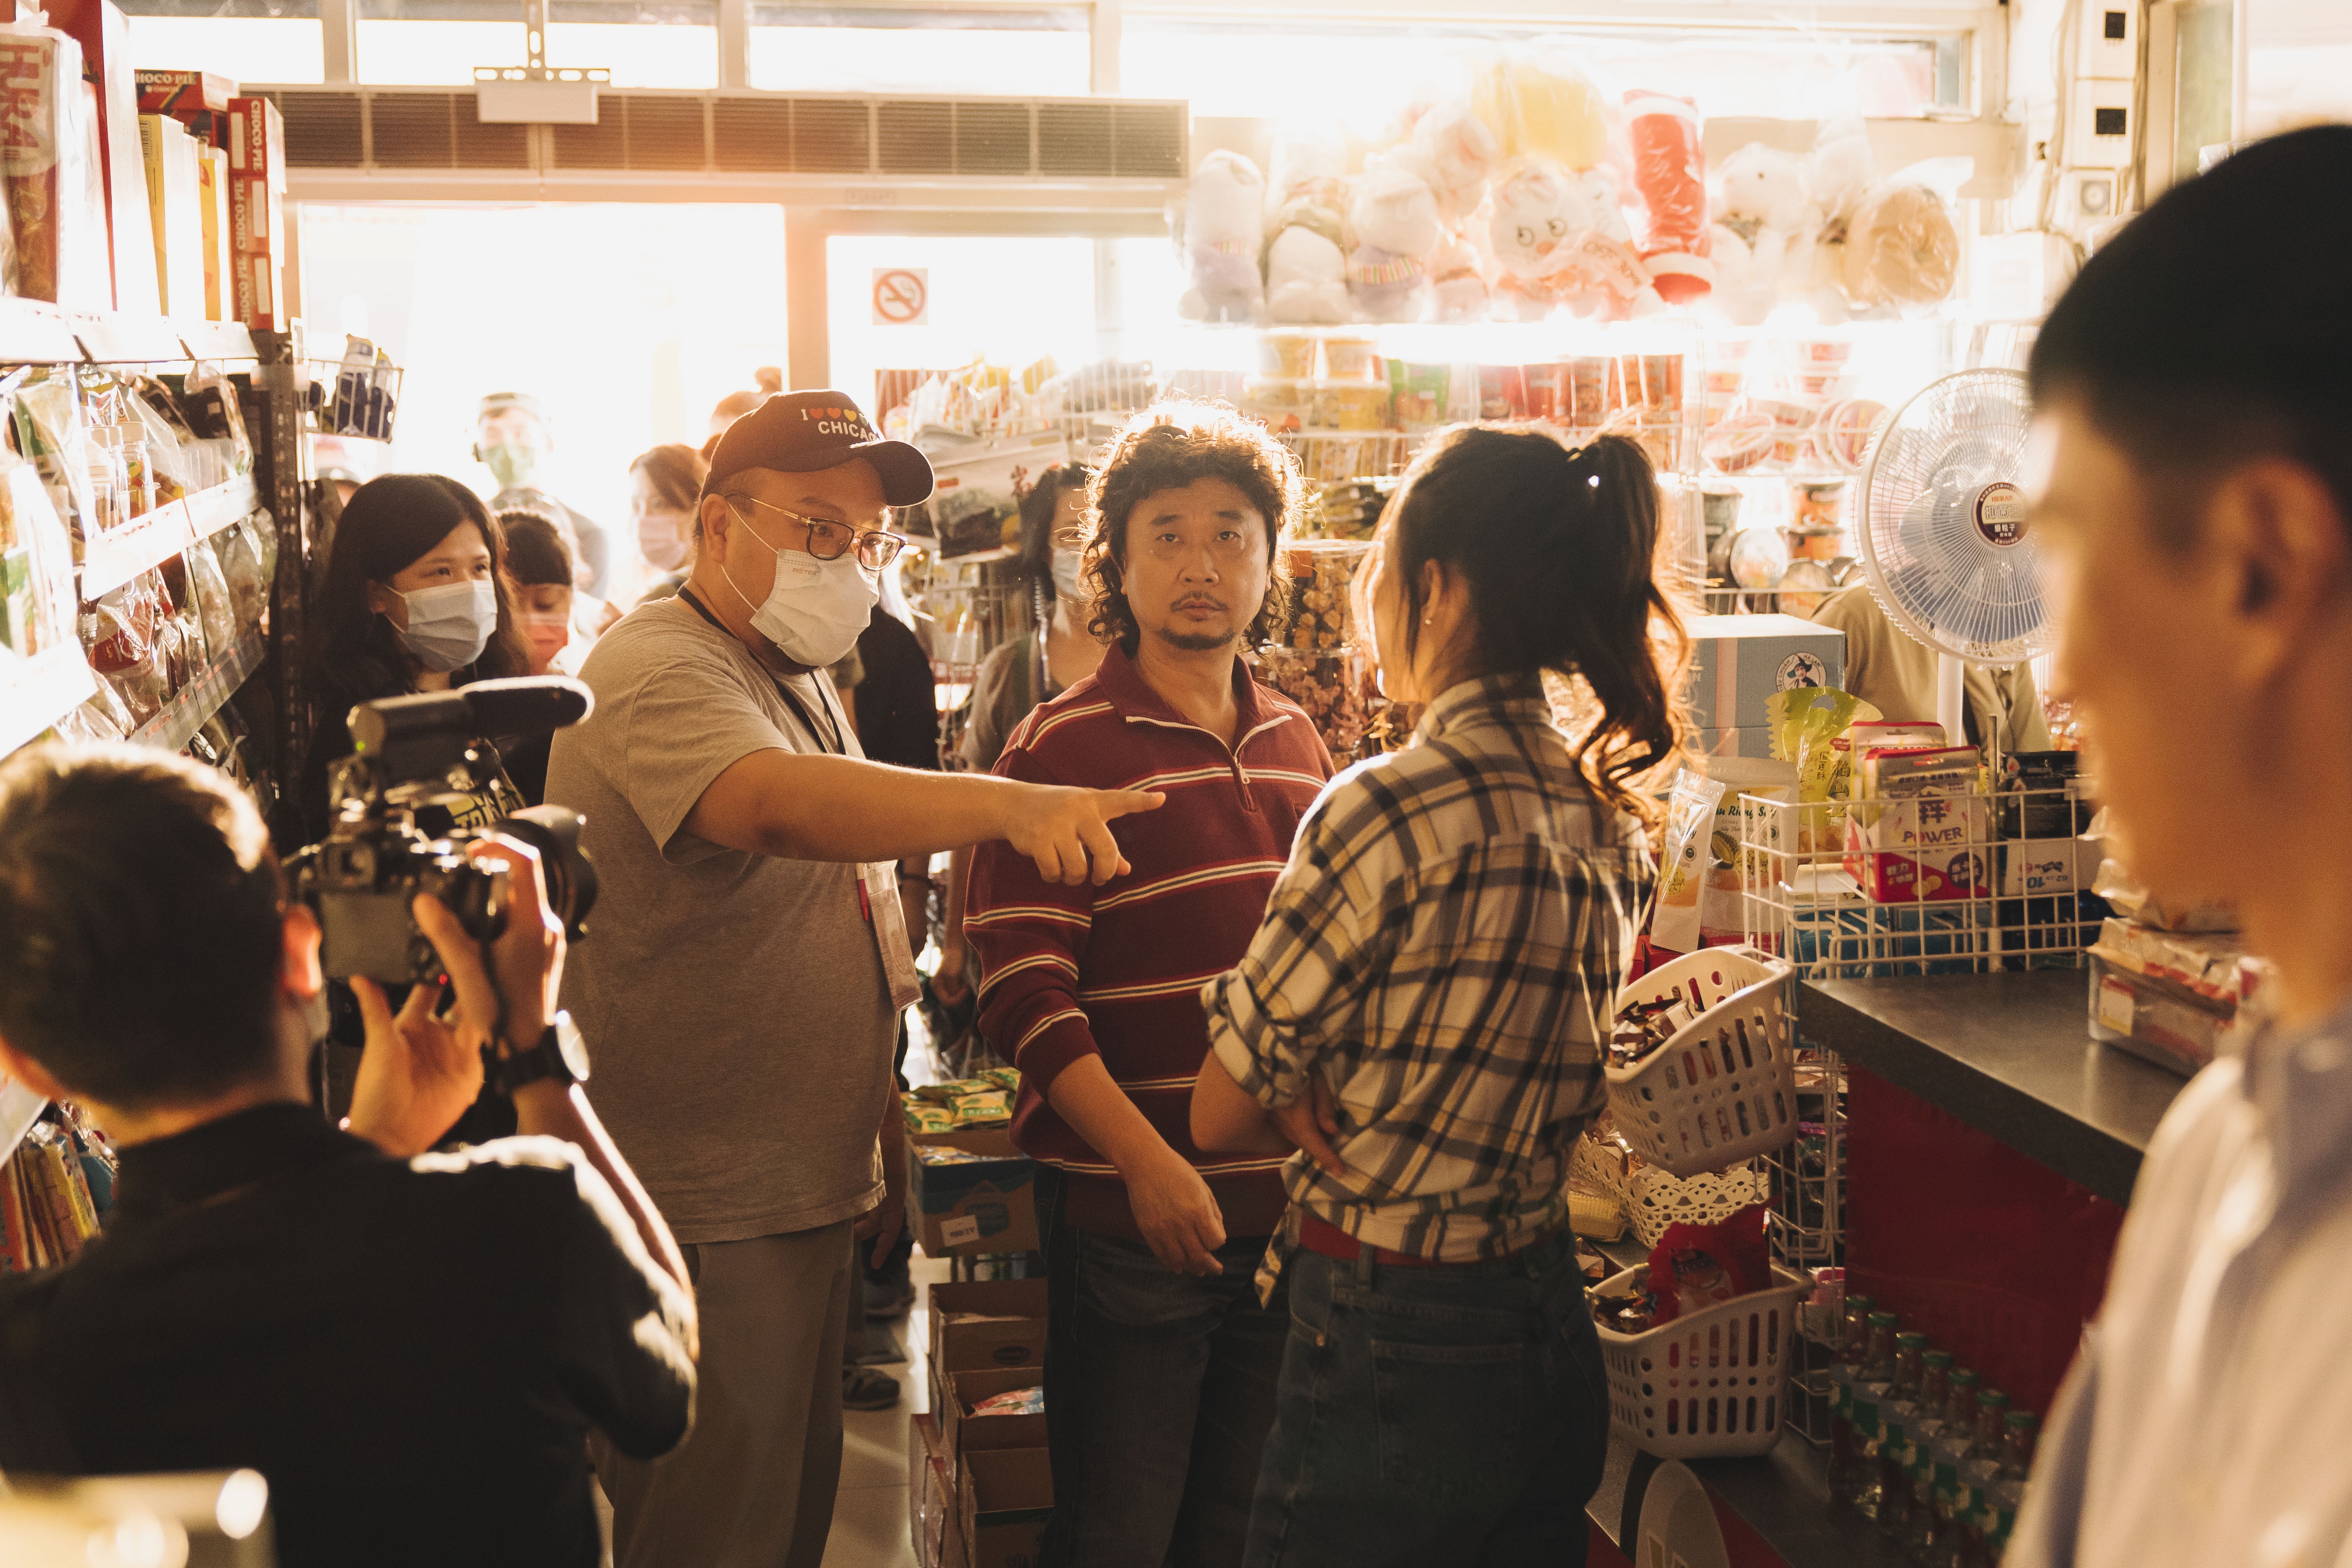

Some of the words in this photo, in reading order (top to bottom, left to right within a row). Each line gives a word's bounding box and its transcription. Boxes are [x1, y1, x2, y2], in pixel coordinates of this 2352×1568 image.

[136, 73, 172, 84] HOCO
[251, 100, 262, 147] CHOCO
[252, 149, 263, 171] PIE
[235, 204, 246, 250] CHOCO
[801, 409, 808, 421] I
[1902, 827, 1963, 843] POWER
